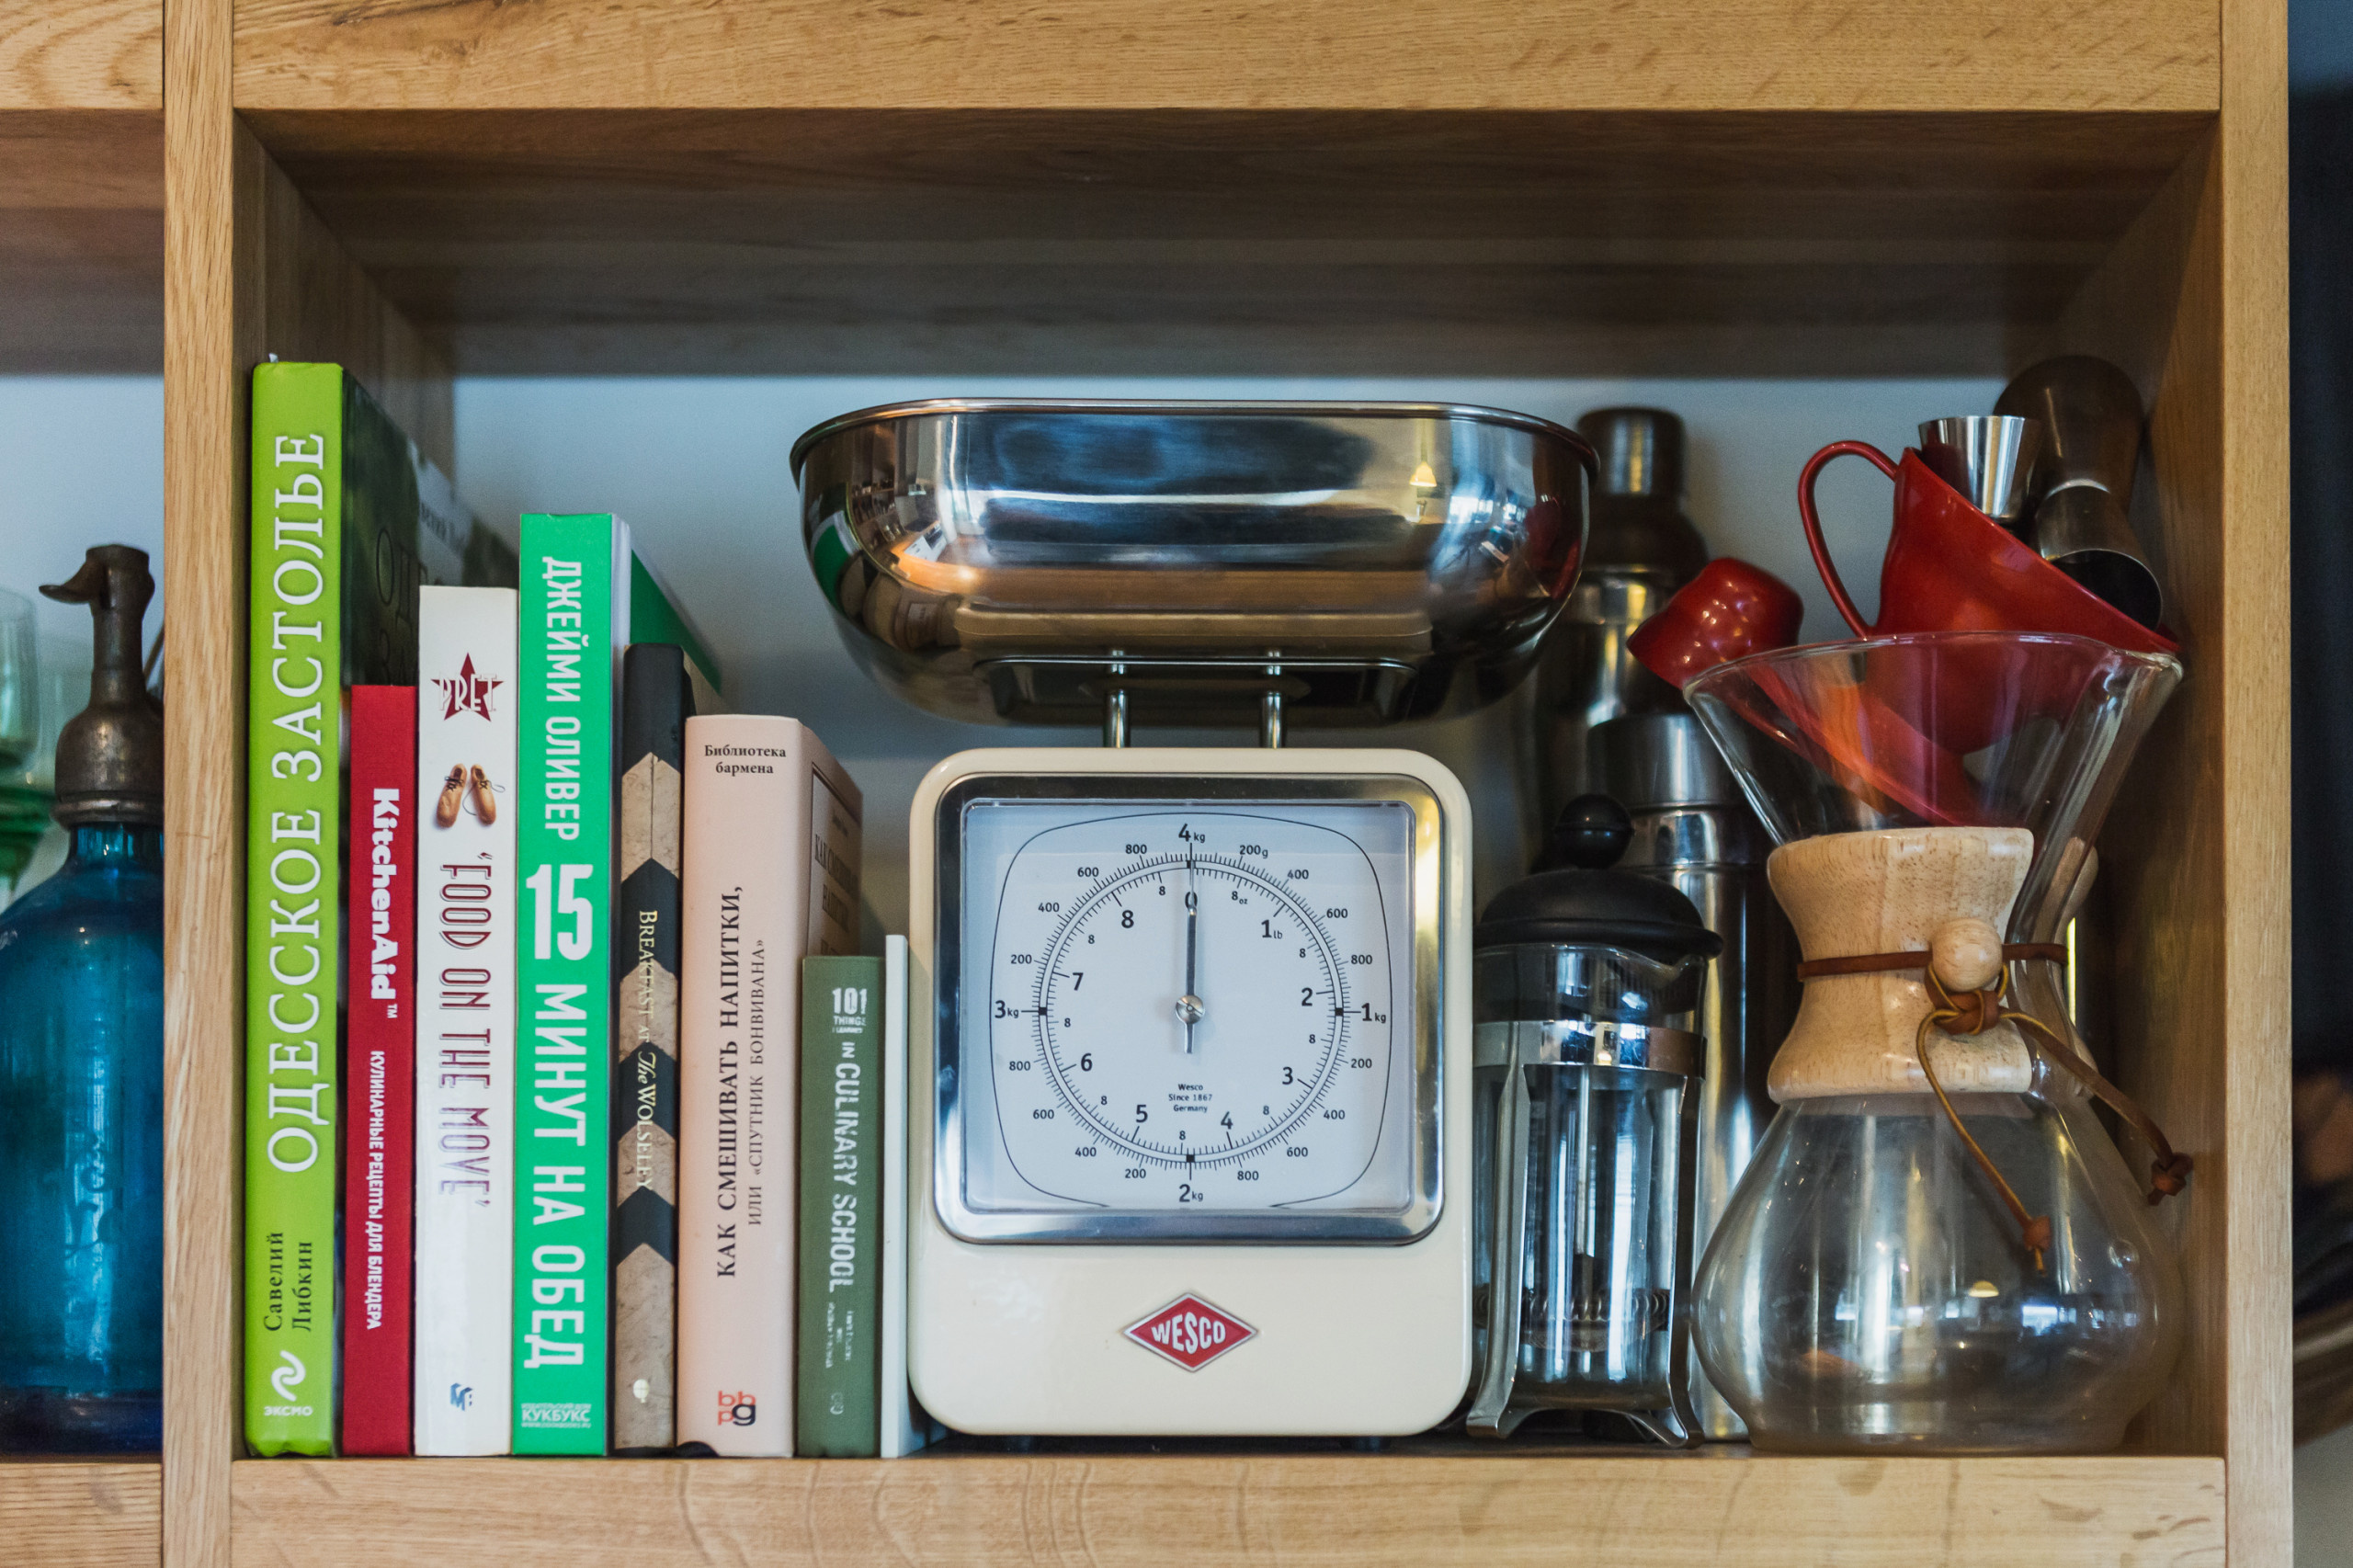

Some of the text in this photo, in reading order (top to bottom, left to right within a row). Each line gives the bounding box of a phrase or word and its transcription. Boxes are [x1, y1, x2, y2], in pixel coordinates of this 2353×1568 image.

[438, 673, 497, 712] PRET
[542, 556, 589, 841] ДЖЕЙМИ ОЛИВЕР
[704, 744, 787, 758] Библиотека
[715, 761, 774, 777] бармена
[267, 434, 330, 1173] ОДЕССКОЕ ЗАСТОЛЬЕ
[1125, 844, 1147, 855] 800
[1077, 867, 1099, 878] 600
[1287, 869, 1309, 880] 400
[1158, 886, 1166, 896] 8
[526, 863, 594, 961] 15
[1038, 903, 1060, 913] 400
[1326, 908, 1348, 919] 600
[1120, 909, 1134, 928] 8
[1087, 935, 1096, 945] 8
[1010, 954, 1032, 965] 200
[1299, 948, 1306, 959] 8
[1350, 954, 1373, 965] 800
[638, 910, 658, 1019] BREAKFAST
[439, 968, 492, 1011] ON
[1072, 972, 1084, 991] 7
[832, 987, 868, 1015] 101
[1301, 987, 1313, 1006] 2
[1063, 1017, 1072, 1028] 8
[1309, 1034, 1316, 1044] 8
[438, 1028, 491, 1089] THE
[841, 1041, 856, 1059] IN
[534, 984, 588, 1147] МИНУТ
[1008, 1061, 1031, 1072] 800
[1080, 1052, 1093, 1072] 6
[1350, 1058, 1372, 1069] 200
[717, 886, 744, 1278] КАК СМЕШИВАТЬ НАПИТКИ,
[748, 939, 766, 1226] ИЛИ «СПУТНИК БОНВИВАНА»
[1281, 1066, 1293, 1085] 3
[1100, 1096, 1108, 1106] 8
[1173, 1104, 1208, 1113] Germany
[1032, 1109, 1055, 1119] 600
[1135, 1104, 1148, 1123] 5
[1263, 1106, 1270, 1116] 8
[1323, 1109, 1346, 1120] 400
[834, 1062, 861, 1186] CULINARY
[1221, 1111, 1233, 1130] 4
[636, 1084, 656, 1191] WOLSELEY
[1178, 1131, 1187, 1141] 8
[1074, 1147, 1097, 1157] 400
[1286, 1147, 1309, 1157] 600
[1124, 1168, 1147, 1178] 200
[1237, 1170, 1259, 1181] 800
[365, 1051, 385, 1331] КУЛИНАРНЫЕ РЕЦЕПТЫ ДЛЯ БЛЕНДЕРА
[533, 1165, 586, 1226] НА
[829, 1193, 858, 1294] SCHOOL
[263, 1232, 285, 1332] Савелий
[291, 1241, 313, 1333] Либкин
[523, 1244, 585, 1369] ОБЕД
[1151, 1312, 1226, 1355] WESCO
[522, 1408, 591, 1422] КУКБУКС
